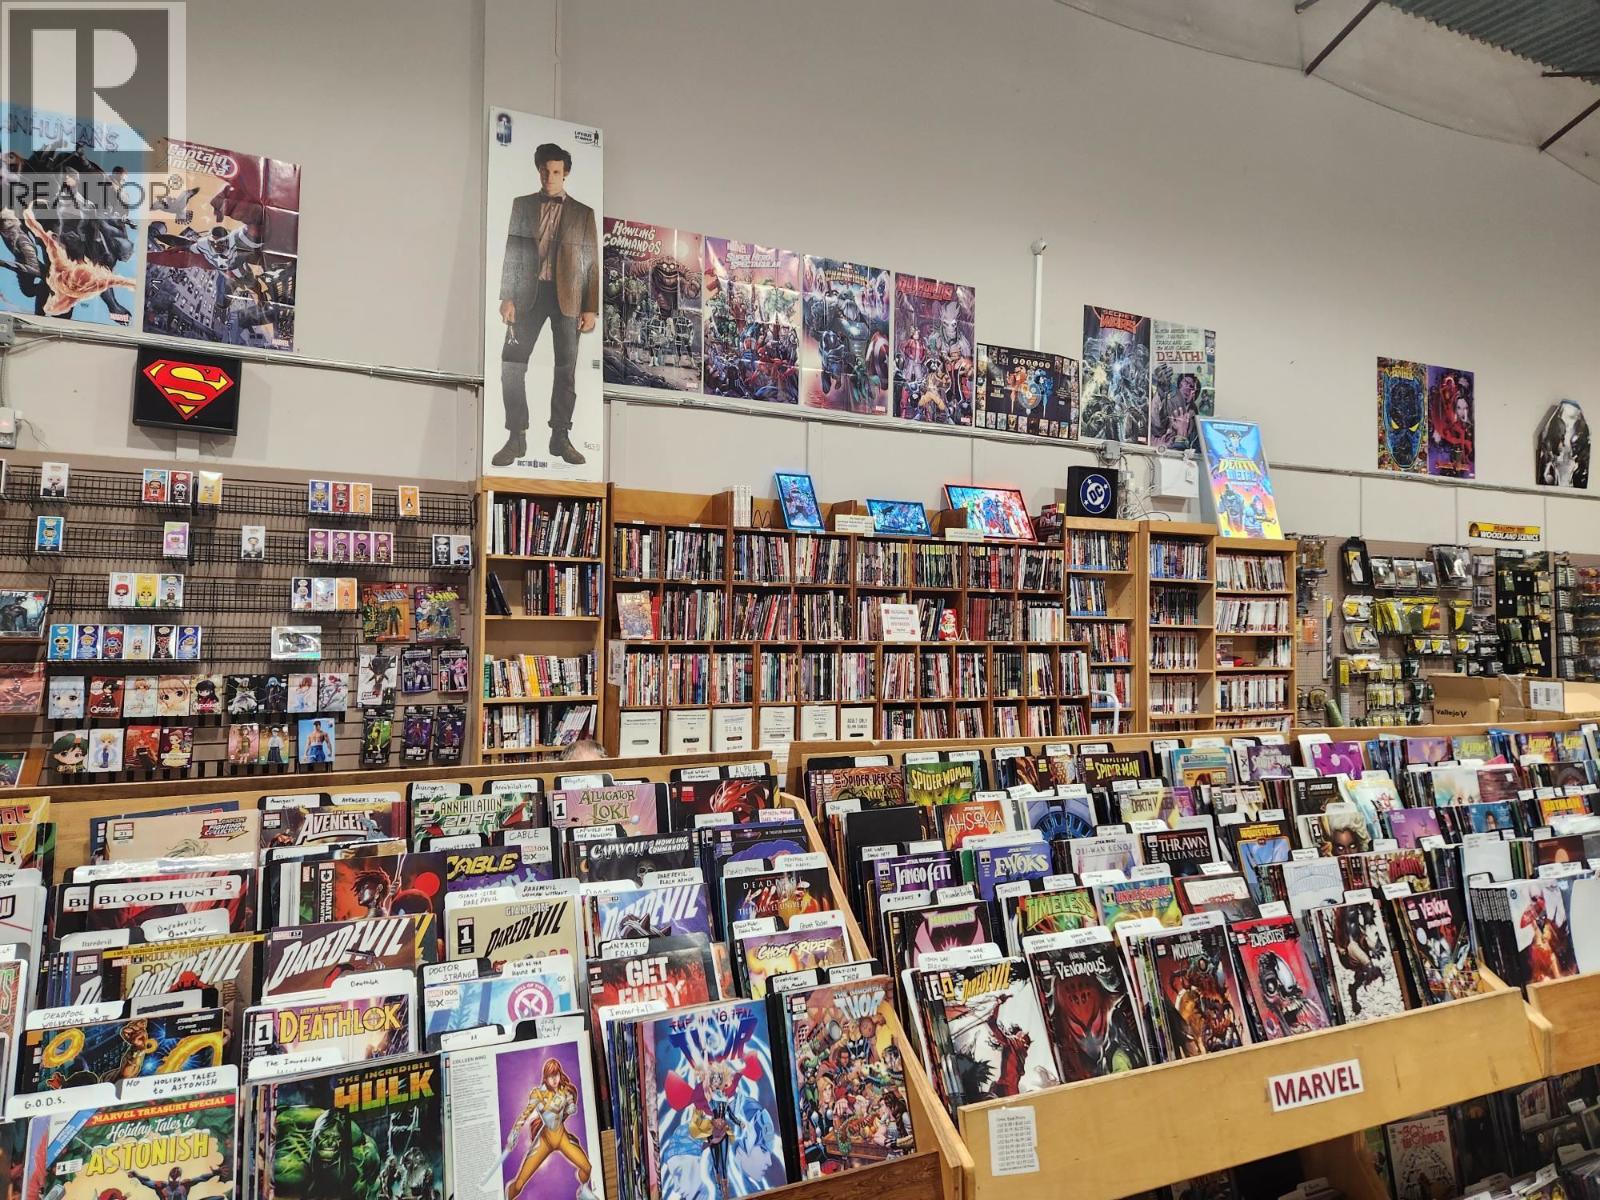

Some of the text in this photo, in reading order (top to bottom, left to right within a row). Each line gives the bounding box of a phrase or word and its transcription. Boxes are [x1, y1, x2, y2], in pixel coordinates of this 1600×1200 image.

[168, 144, 228, 165] Captain
[165, 156, 233, 178] America
[612, 220, 656, 241] HOWLING
[602, 233, 662, 256] COMMANDOS
[1155, 351, 1204, 362] DEATH!
[1088, 488, 1107, 503] DC
[1480, 531, 1539, 541] WOODLAND SCENICS
[1436, 708, 1460, 718] vallejo
[911, 765, 973, 791] SPIDER-WOMAN
[1095, 760, 1140, 779] SPIDER-MAN
[415, 784, 444, 793] Avengers
[494, 783, 533, 791] Annihilation
[843, 771, 898, 788] SPIDER-VERSE
[440, 798, 502, 815] ANNIHILATION
[578, 789, 636, 805] ALLIGATOR
[556, 802, 565, 817] 1
[592, 802, 630, 824] LOKI
[445, 812, 497, 828] 2099
[946, 808, 1003, 832] AHSOKA
[509, 831, 540, 841] CABLE
[655, 837, 688, 848] HOWLING
[1158, 835, 1208, 852] THRAWN
[648, 843, 689, 855] COMMANDOS
[1161, 848, 1210, 861] ALLIANCES
[447, 852, 519, 880] CABLE
[994, 854, 1051, 877] EWOKS
[225, 881, 233, 890] 5
[893, 862, 952, 893] JANGO FETT
[99, 886, 218, 905] BLOOD HUNT
[505, 903, 551, 917] GIANT-SIZE
[1024, 891, 1098, 930] TIMELESS
[1419, 898, 1452, 919] VENOM
[460, 926, 472, 945] 1
[485, 901, 568, 959] DAREDEVIL
[82, 939, 112, 948] Daredevil
[756, 938, 835, 961] GHOST RIDER
[262, 917, 410, 996] DAREDEVIL
[128, 942, 250, 998] DAREDEVIL
[428, 964, 460, 976] DOCTOR
[443, 969, 477, 982] STRANGE
[625, 956, 669, 988] GET
[1055, 956, 1108, 980] VENOMOUS
[945, 979, 954, 997] 1
[961, 961, 1012, 1004] DAREDEVIL
[833, 989, 886, 1019] THOR
[41, 1018, 86, 1028] WOLVERINE
[43, 1010, 84, 1021] DEADPOOL
[278, 1002, 401, 1045] DEATHLOK
[258, 1025, 269, 1042] 1
[153, 1071, 217, 1086] HOLIDAY TALES
[337, 1061, 431, 1085] THE INCREDIBLE
[153, 1079, 218, 1095] to ASTONISH
[334, 1068, 435, 1113] HULK
[1274, 1065, 1360, 1106] MARVEL
[24, 1097, 66, 1109] G.O.D.S.
[92, 1096, 226, 1125] MARVEL TREASURY SPECIAL
[107, 1123, 151, 1143] Holiday
[154, 1117, 182, 1134] Tales
[183, 1113, 195, 1127] to
[86, 1132, 210, 1177] ASTONISH
